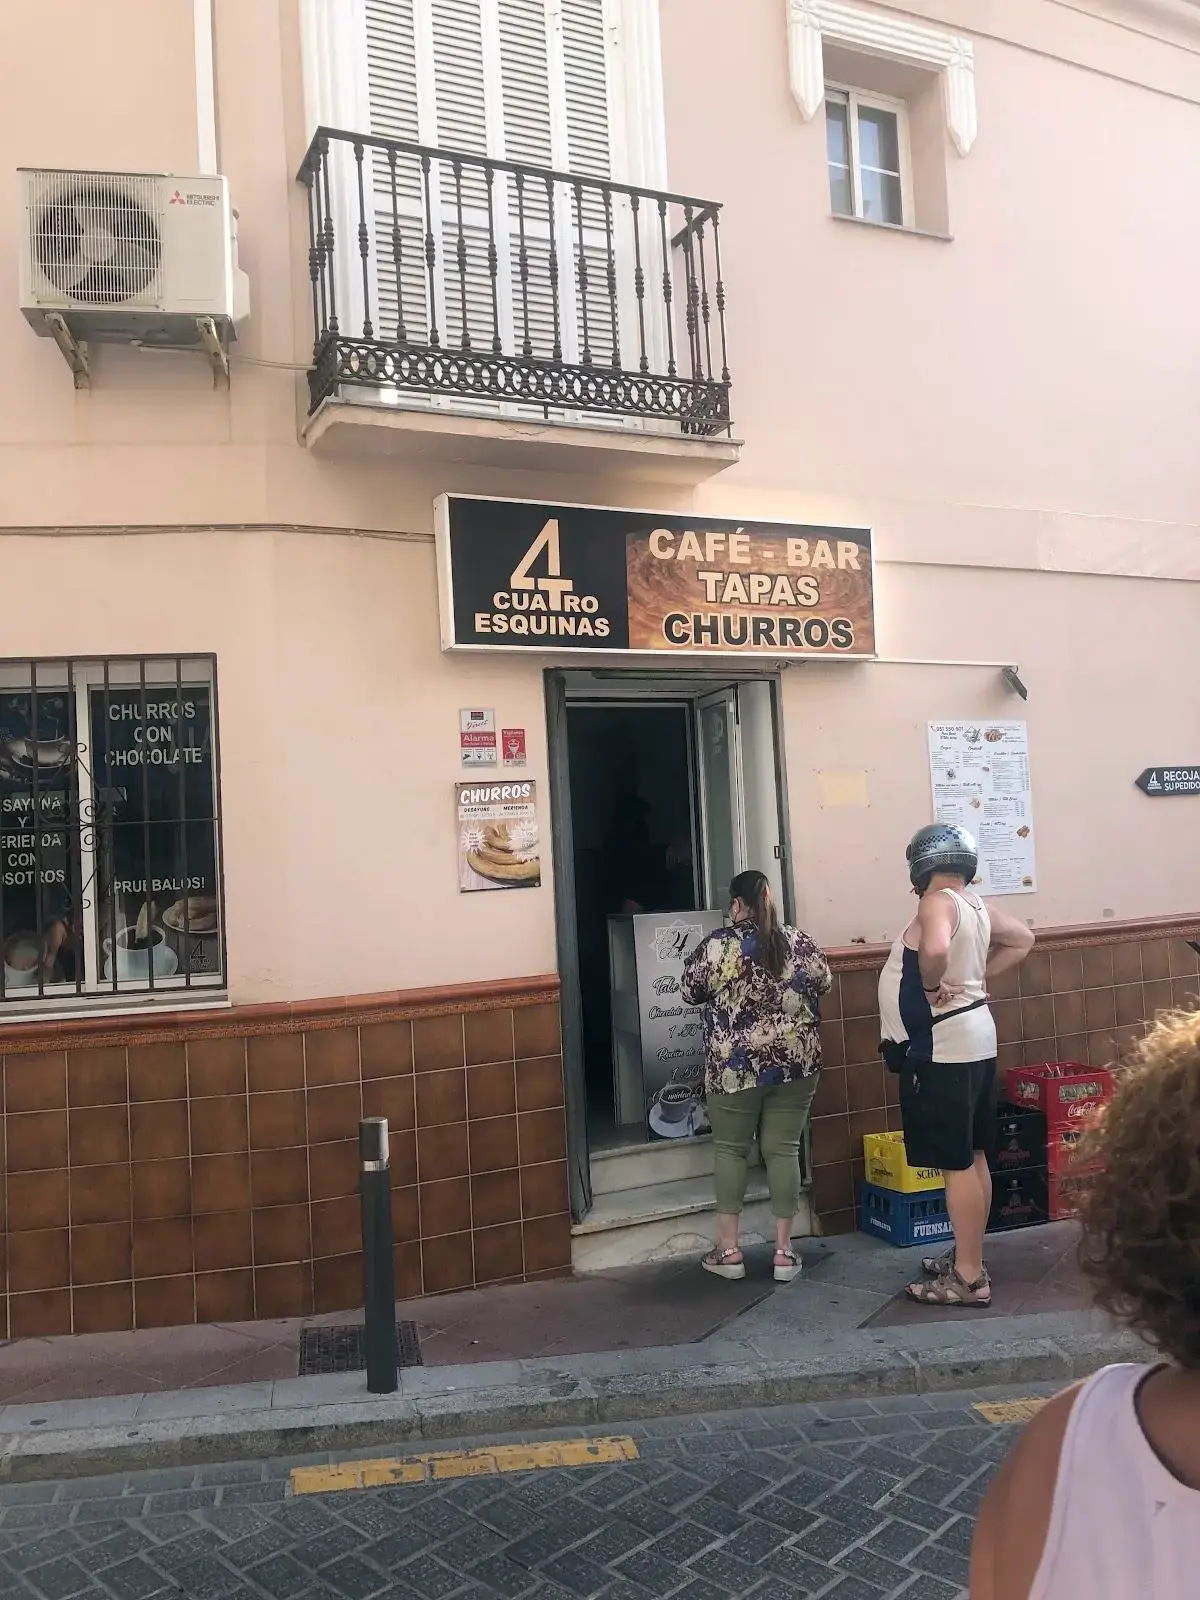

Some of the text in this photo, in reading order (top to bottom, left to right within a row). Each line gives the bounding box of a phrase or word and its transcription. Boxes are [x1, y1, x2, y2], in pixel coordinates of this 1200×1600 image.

[510, 518, 562, 590] 4
[648, 527, 751, 564] CAFÉ
[786, 538, 861, 570] BAR
[493, 580, 599, 613] CUATRO
[698, 571, 820, 607] TAPAS
[474, 613, 610, 637] ESQUINAS
[662, 612, 856, 649] CHURROS
[109, 702, 196, 720] CHURROS
[133, 726, 172, 742] CON
[463, 734, 495, 742] Alarma
[1163, 771, 1200, 781] RECOJA
[460, 783, 531, 804] CHURROS
[18, 816, 28, 828] Y
[652, 975, 680, 996] Take
